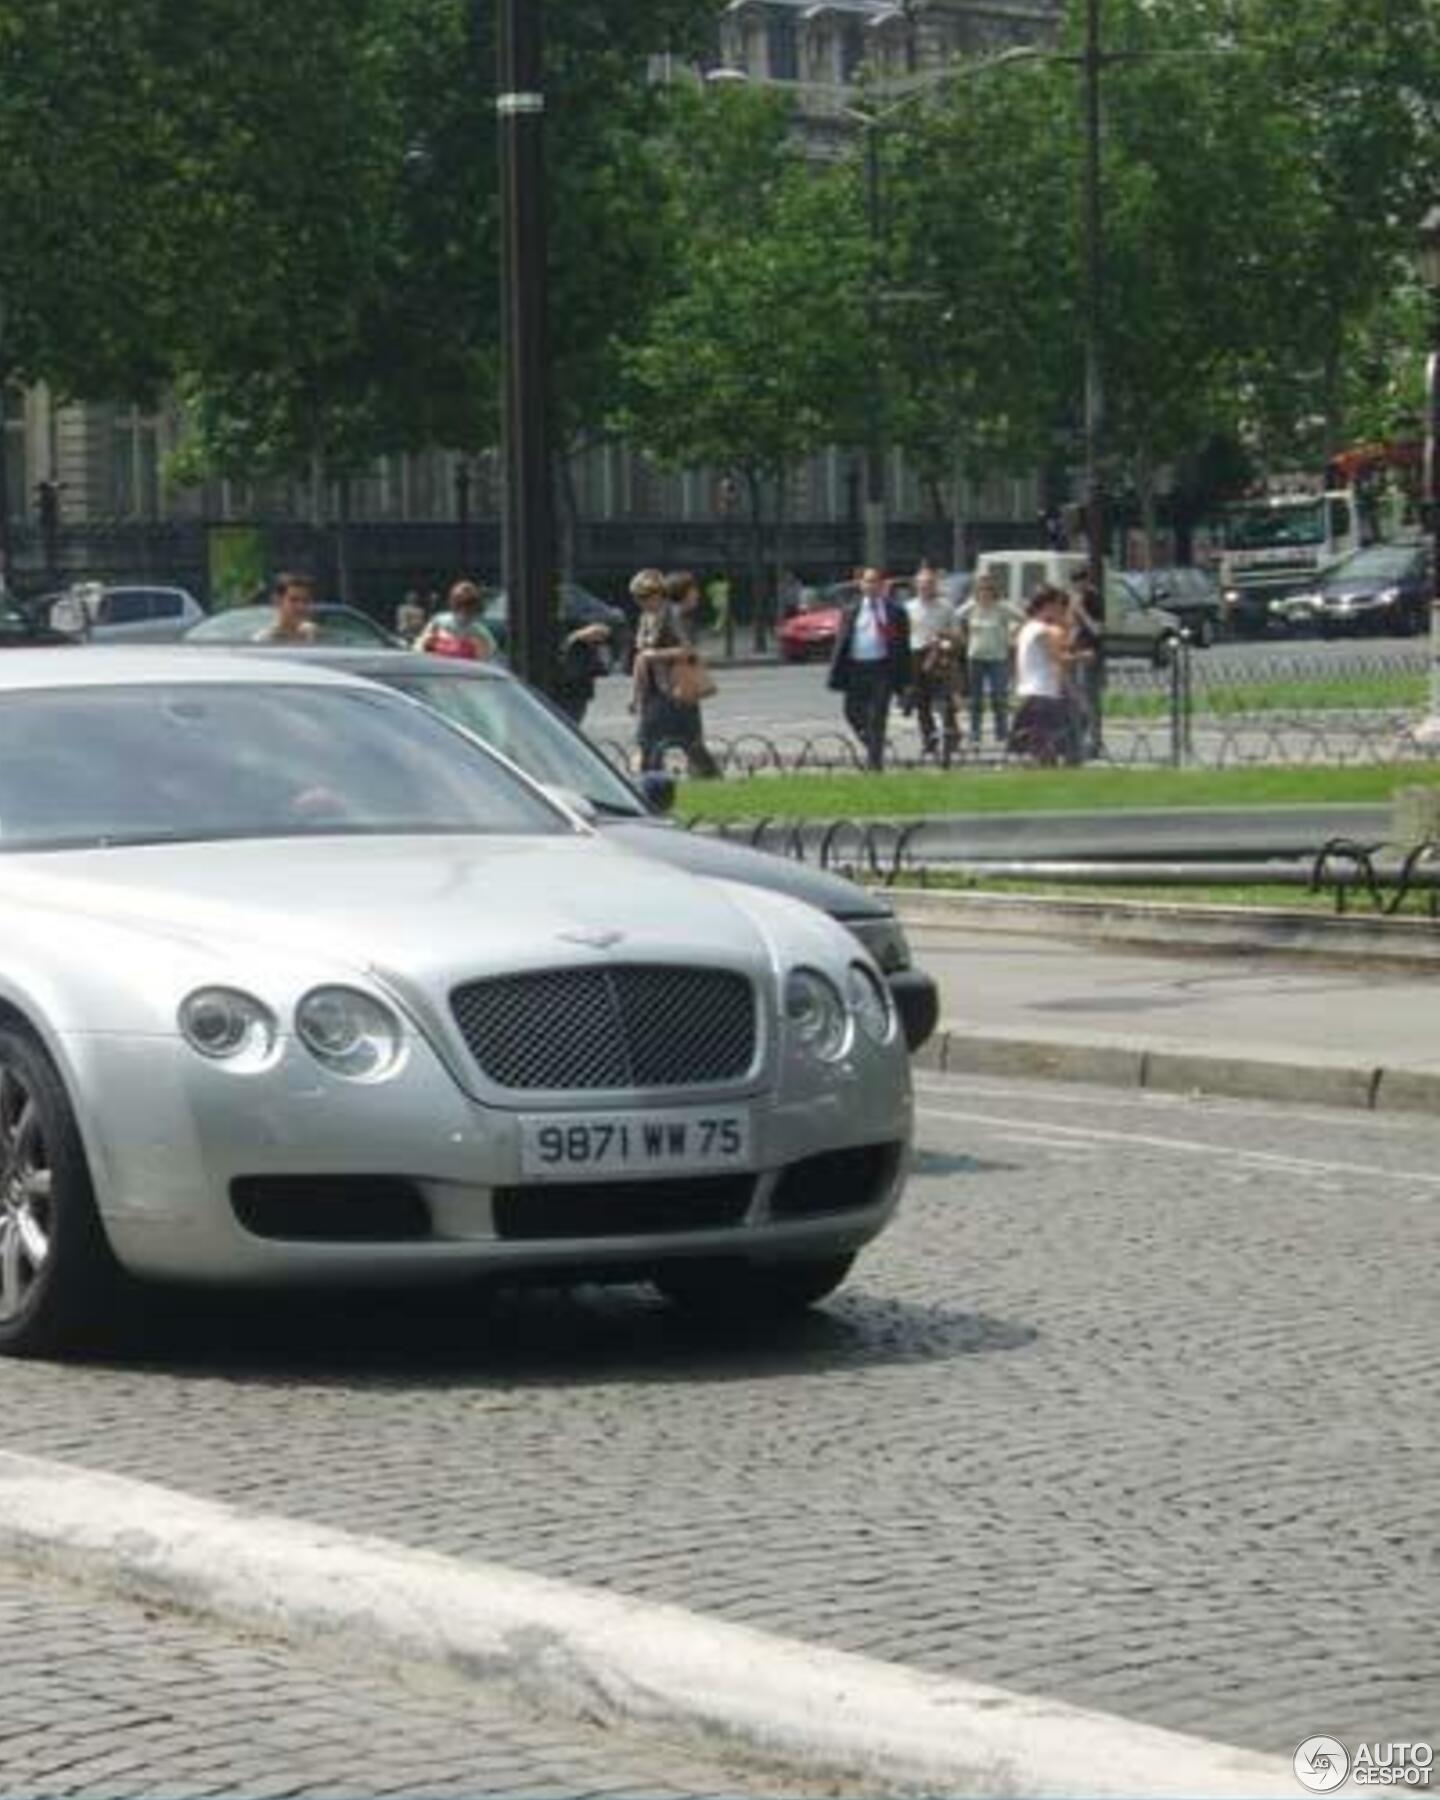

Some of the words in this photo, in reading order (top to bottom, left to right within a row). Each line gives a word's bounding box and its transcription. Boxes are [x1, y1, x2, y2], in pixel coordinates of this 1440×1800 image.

[539, 1123, 629, 1163] 9871
[642, 1121, 687, 1157] WW
[696, 1117, 741, 1155] 75
